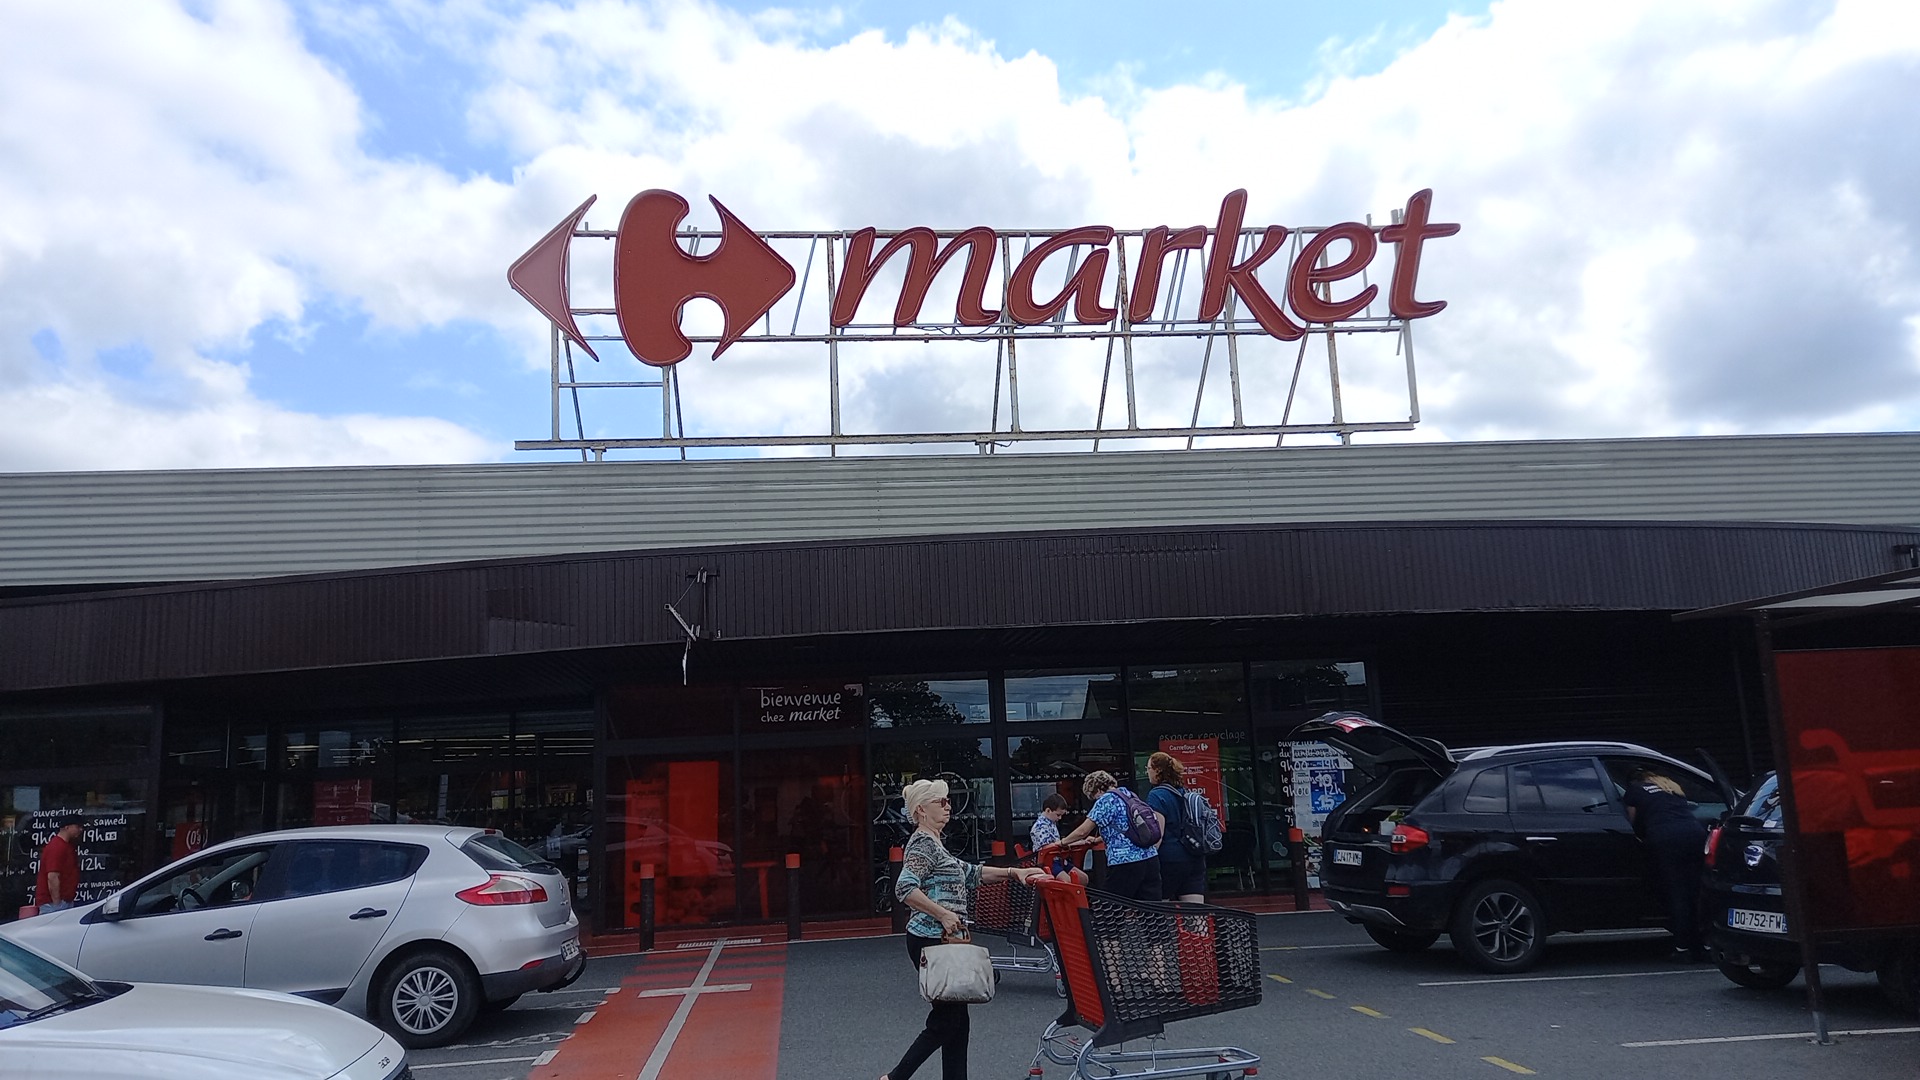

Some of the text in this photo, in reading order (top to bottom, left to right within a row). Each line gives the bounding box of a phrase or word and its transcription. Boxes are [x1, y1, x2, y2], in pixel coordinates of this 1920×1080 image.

[831, 189, 1460, 341] market
[760, 690, 841, 708] bienvenue
[761, 707, 841, 723] chez market
[33, 807, 83, 817] ouverture
[32, 819, 46, 829] du
[94, 814, 127, 827] samedi
[30, 848, 39, 859] le
[81, 857, 106, 872] 12h
[90, 879, 121, 889] magasin
[73, 890, 94, 902] 24h
